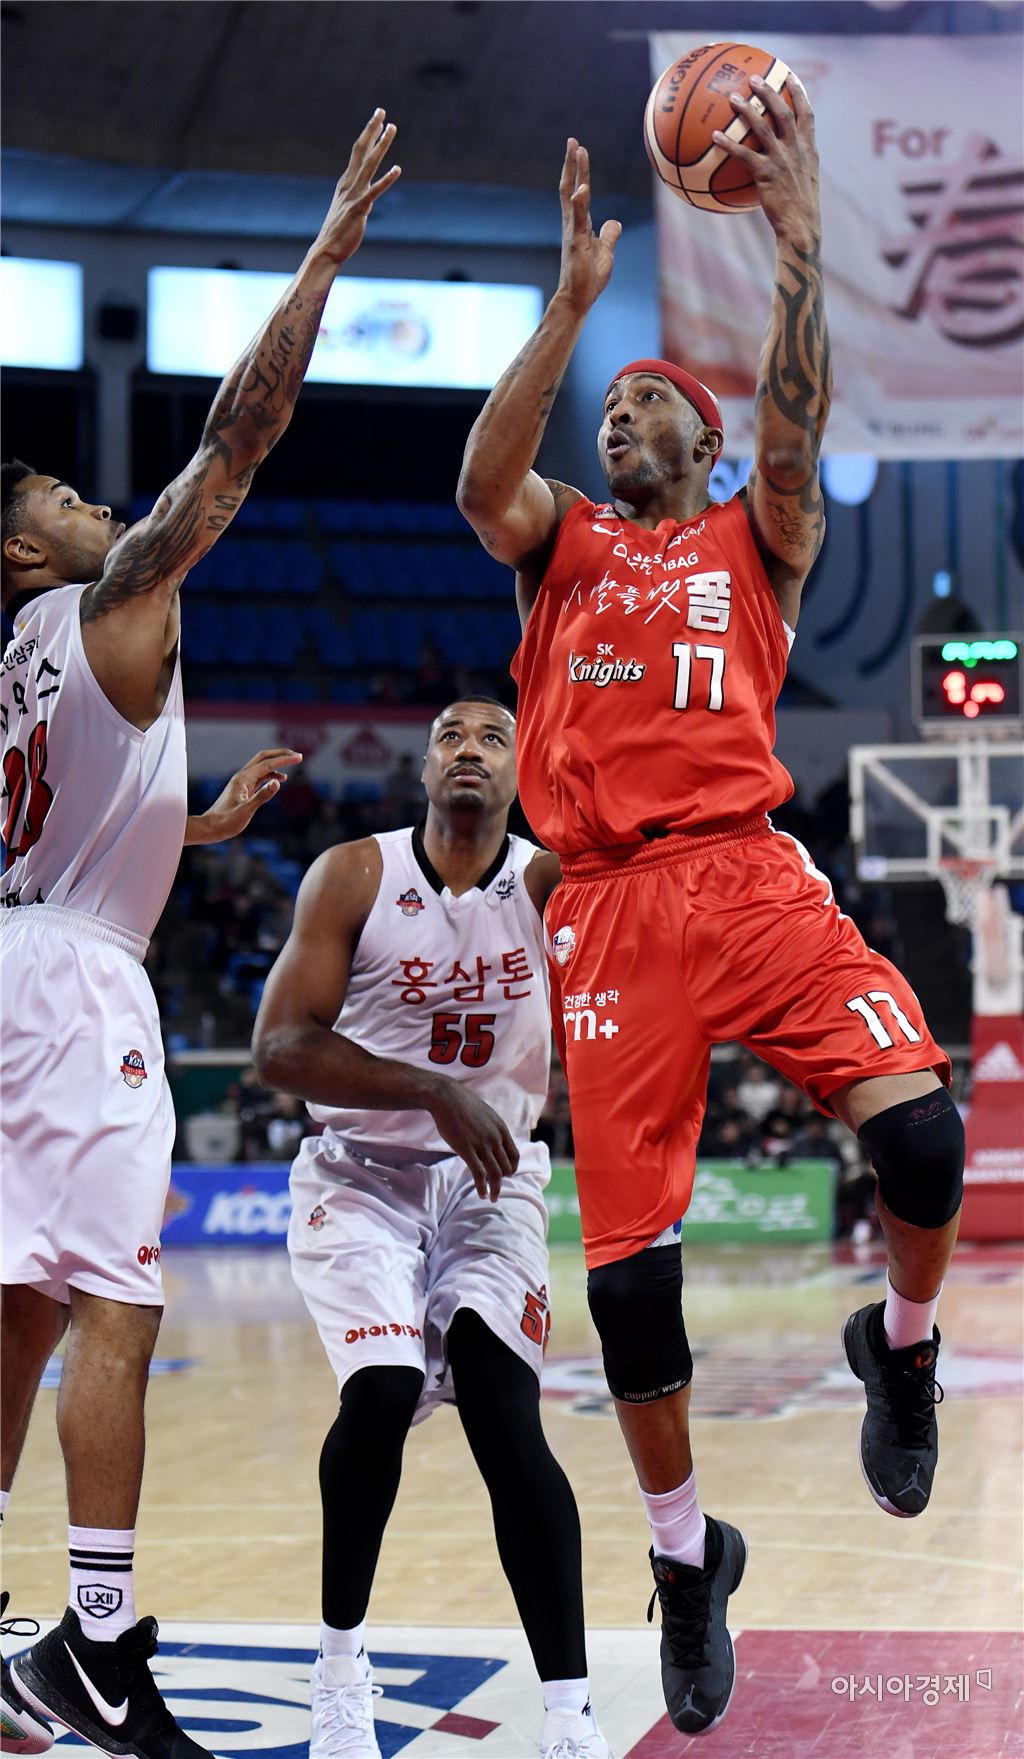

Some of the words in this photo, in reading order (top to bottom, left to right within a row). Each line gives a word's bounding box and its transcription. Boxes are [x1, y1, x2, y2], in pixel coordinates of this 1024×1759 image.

[872, 118, 950, 158] For
[568, 650, 646, 687] Knights
[597, 644, 614, 656] SK
[672, 643, 726, 711] 17
[391, 947, 534, 1005] 홍삼톤
[564, 992, 592, 1009] 건강한
[594, 990, 620, 1007] 생각
[844, 990, 922, 1051] 17
[428, 1013, 496, 1068] 55
[203, 1190, 292, 1235] KCC
[85, 1591, 114, 1605] LXII
